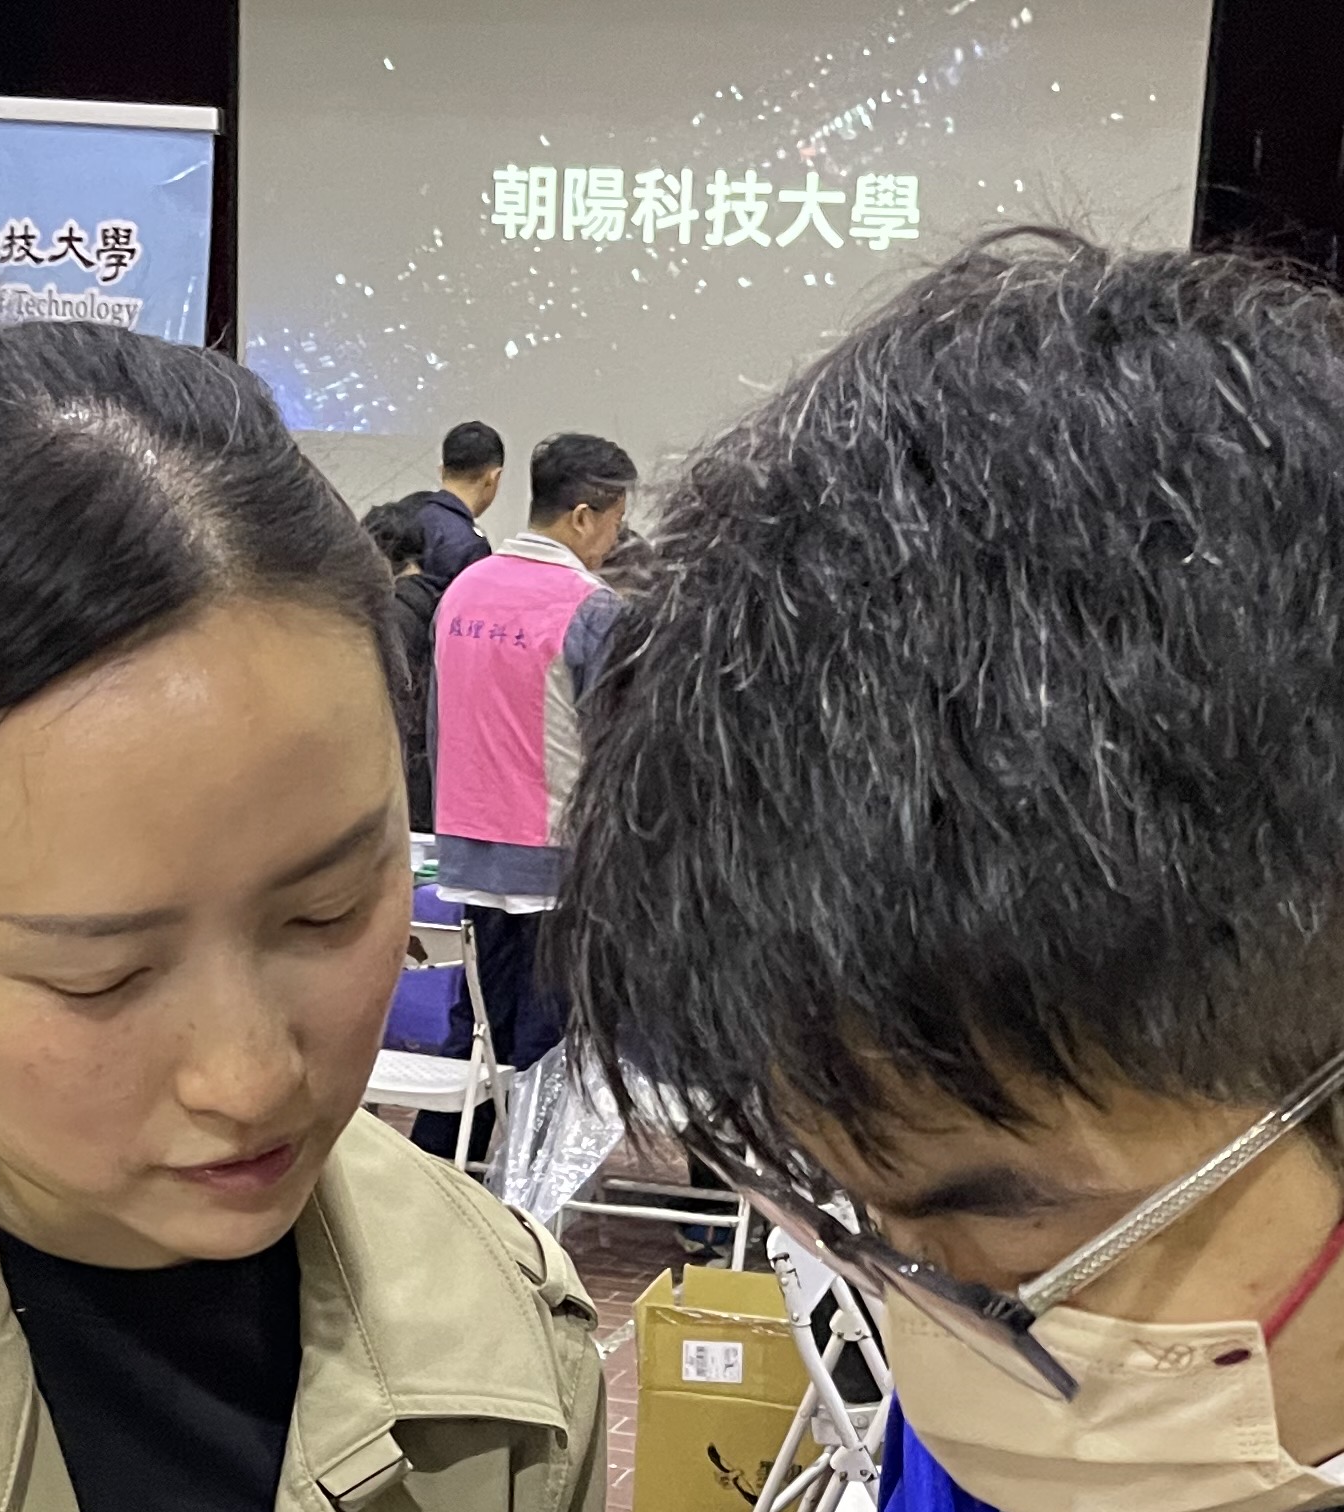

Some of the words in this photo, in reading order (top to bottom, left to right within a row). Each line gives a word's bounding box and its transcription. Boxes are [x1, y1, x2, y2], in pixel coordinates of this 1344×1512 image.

[490, 163, 922, 251] 朝陽科技大學
[15, 289, 139, 325] Technology
